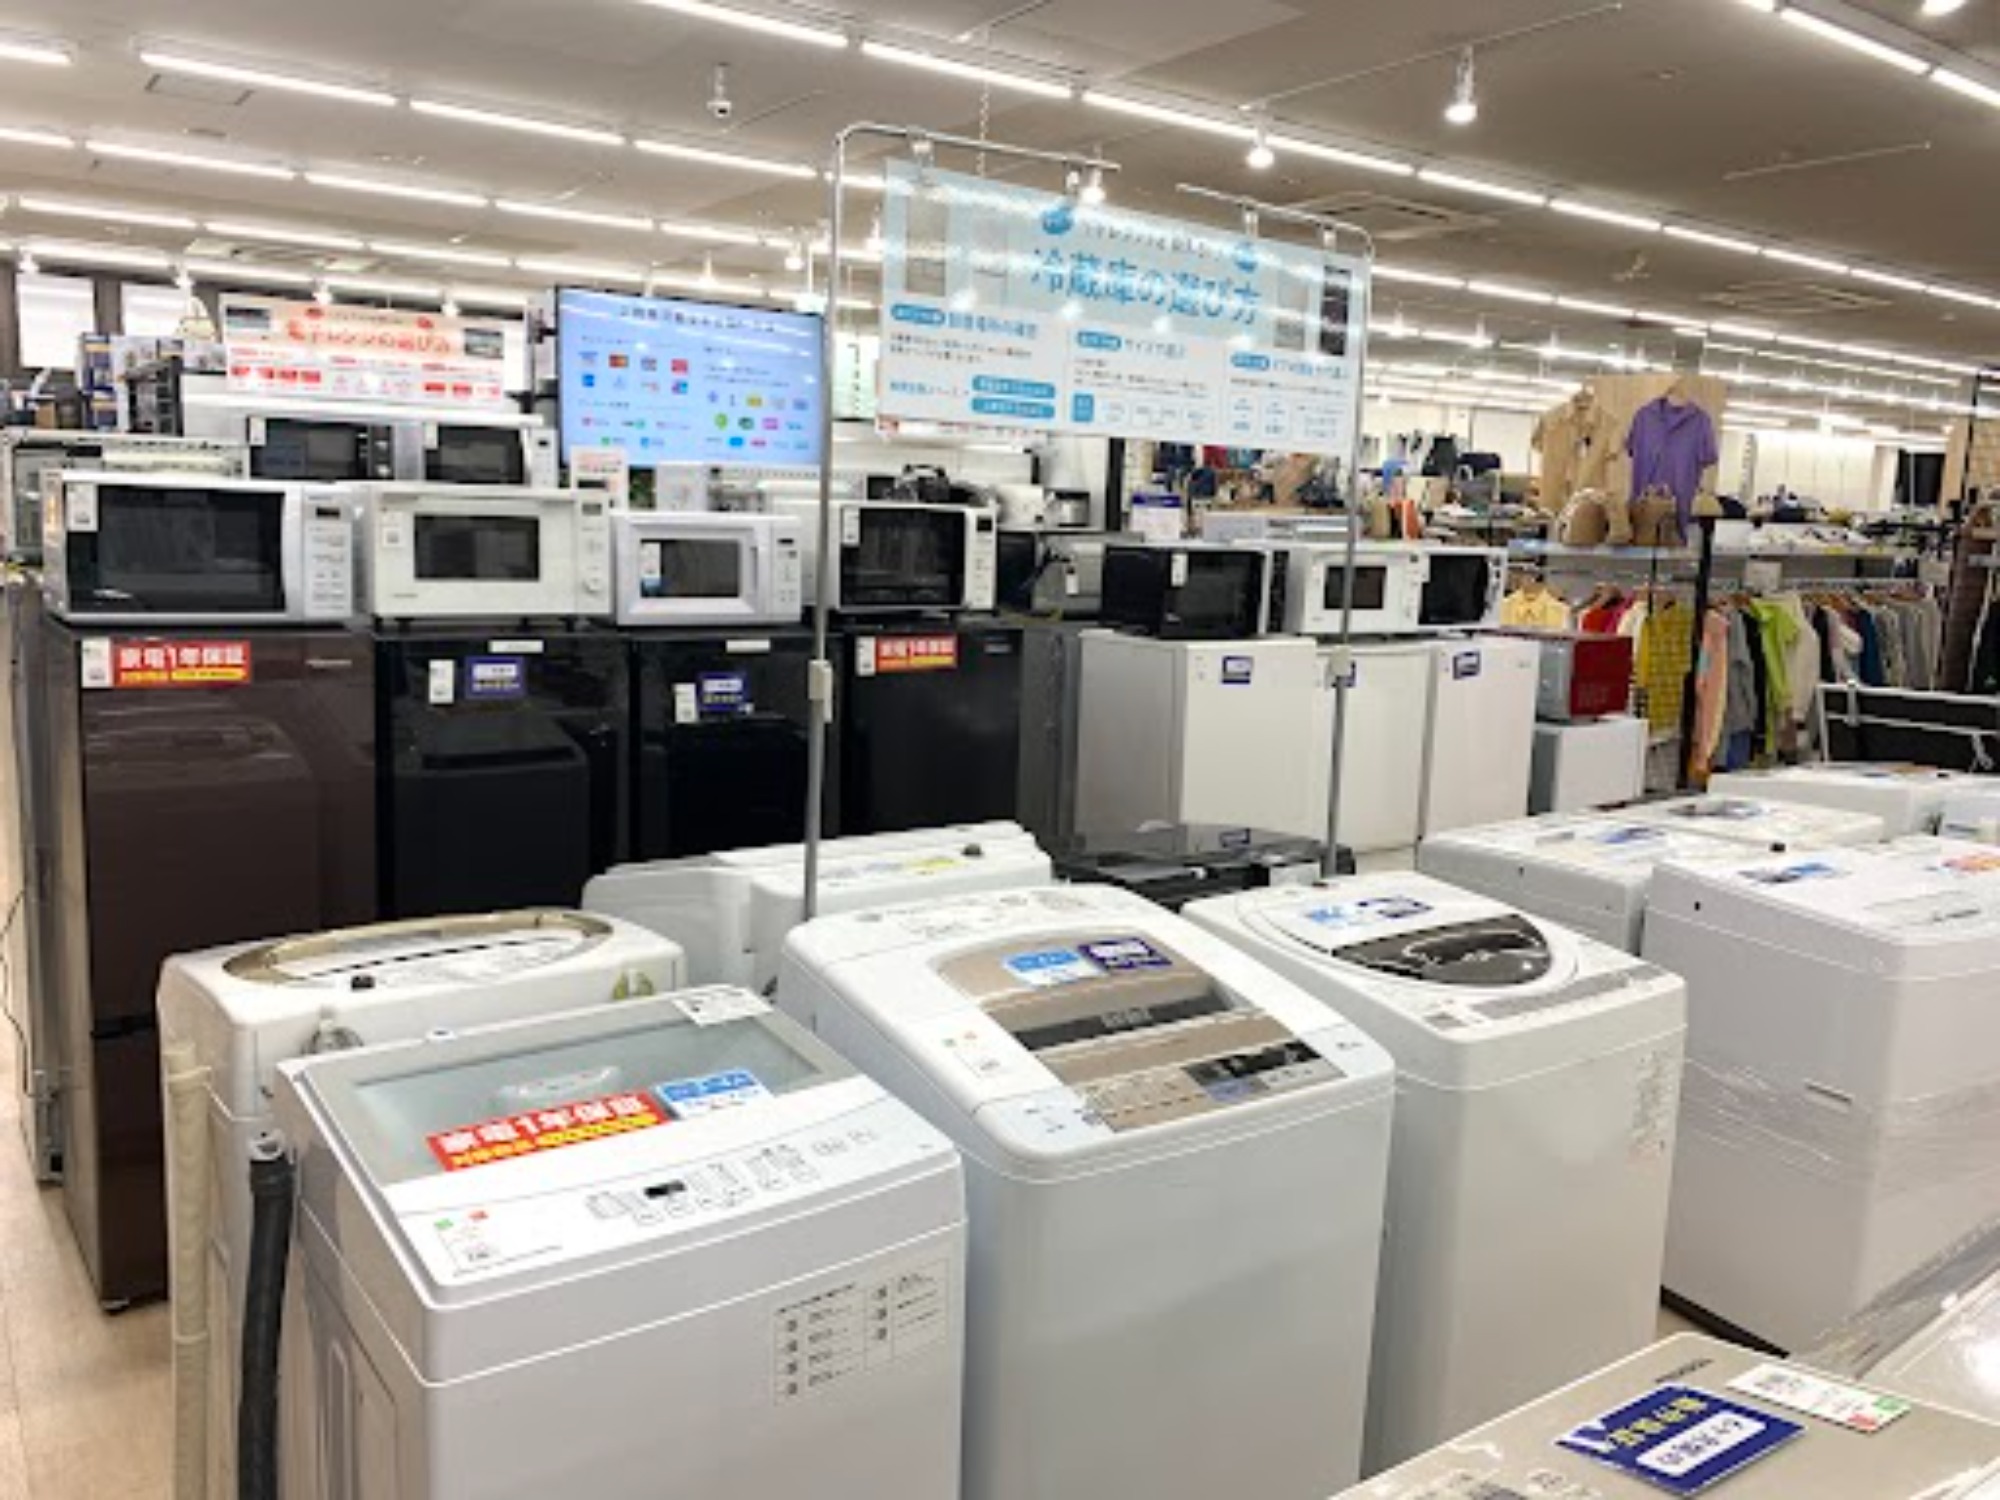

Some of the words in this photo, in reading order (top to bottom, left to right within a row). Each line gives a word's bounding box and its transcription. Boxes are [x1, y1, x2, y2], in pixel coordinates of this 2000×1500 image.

[1031, 248, 1260, 325] 冷蔵庫の選び方
[438, 1096, 650, 1153] 家電1年保証
